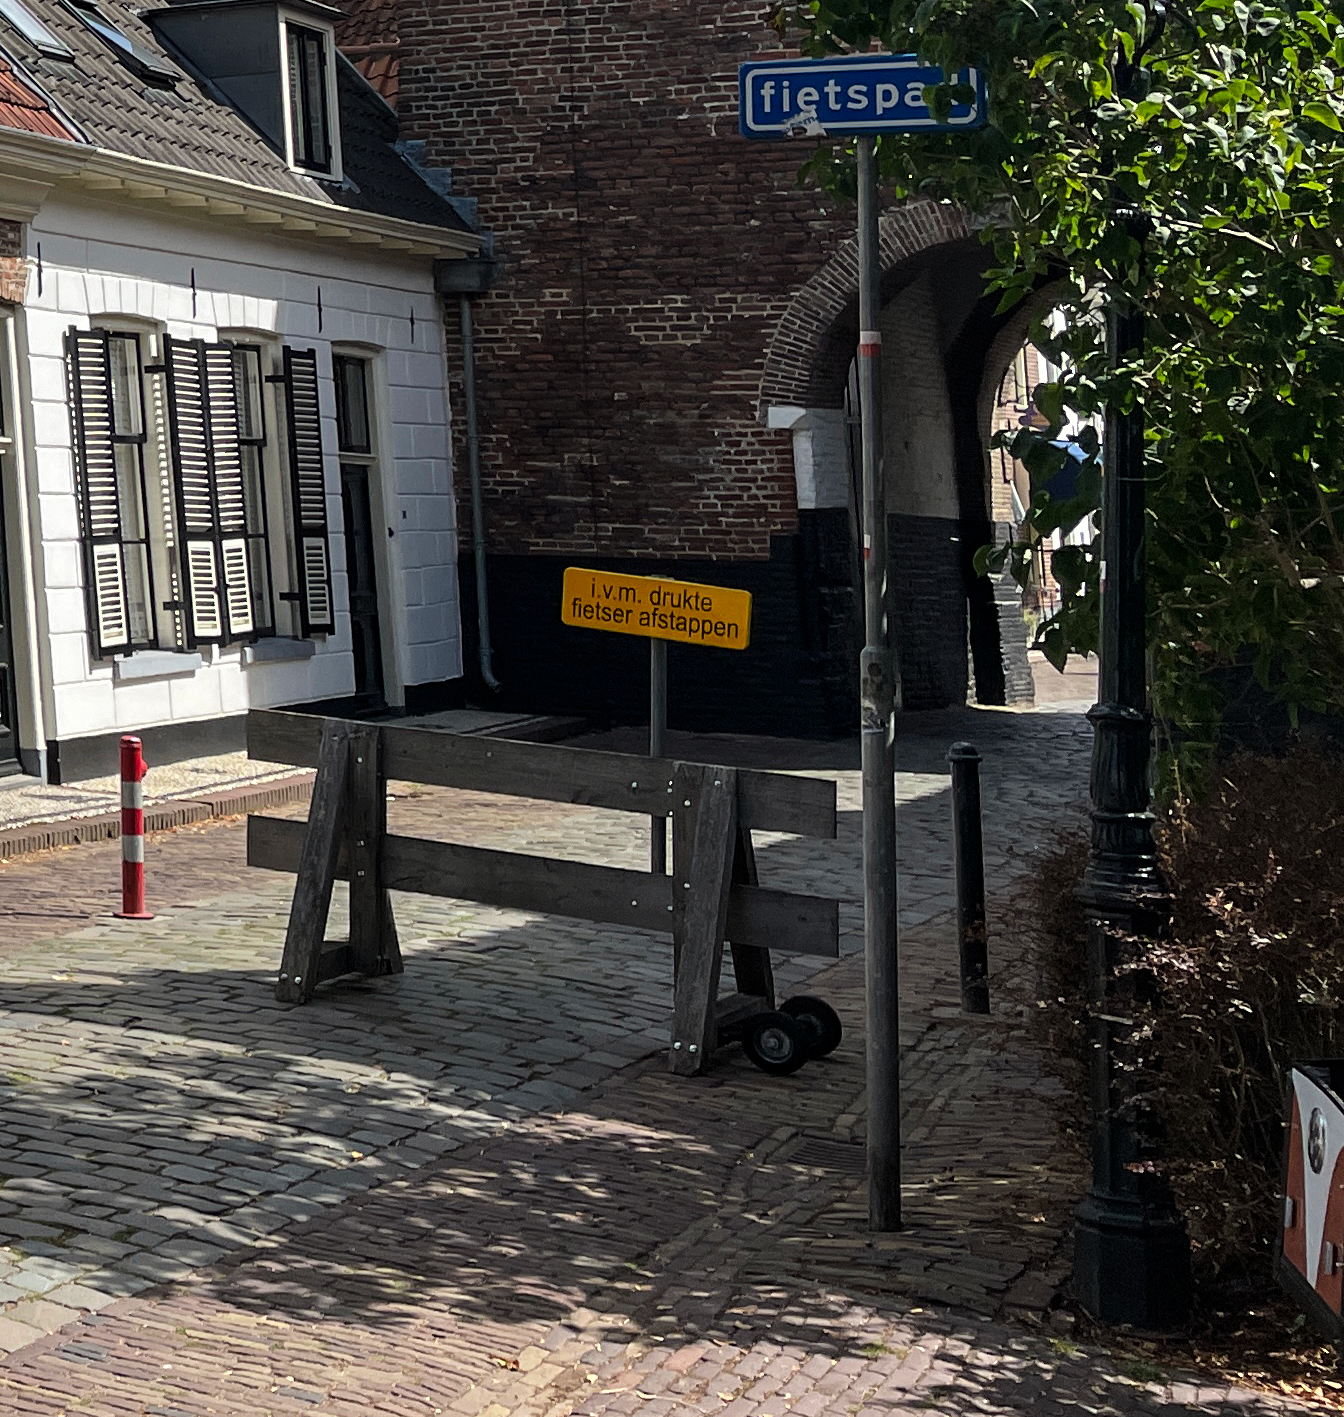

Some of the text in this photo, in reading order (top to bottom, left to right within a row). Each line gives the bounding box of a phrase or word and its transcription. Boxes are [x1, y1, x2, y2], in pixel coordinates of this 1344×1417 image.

[759, 73, 959, 116] fietspa
[590, 577, 713, 613] i.v.m. drukte
[571, 597, 740, 640] fietser afstappen
